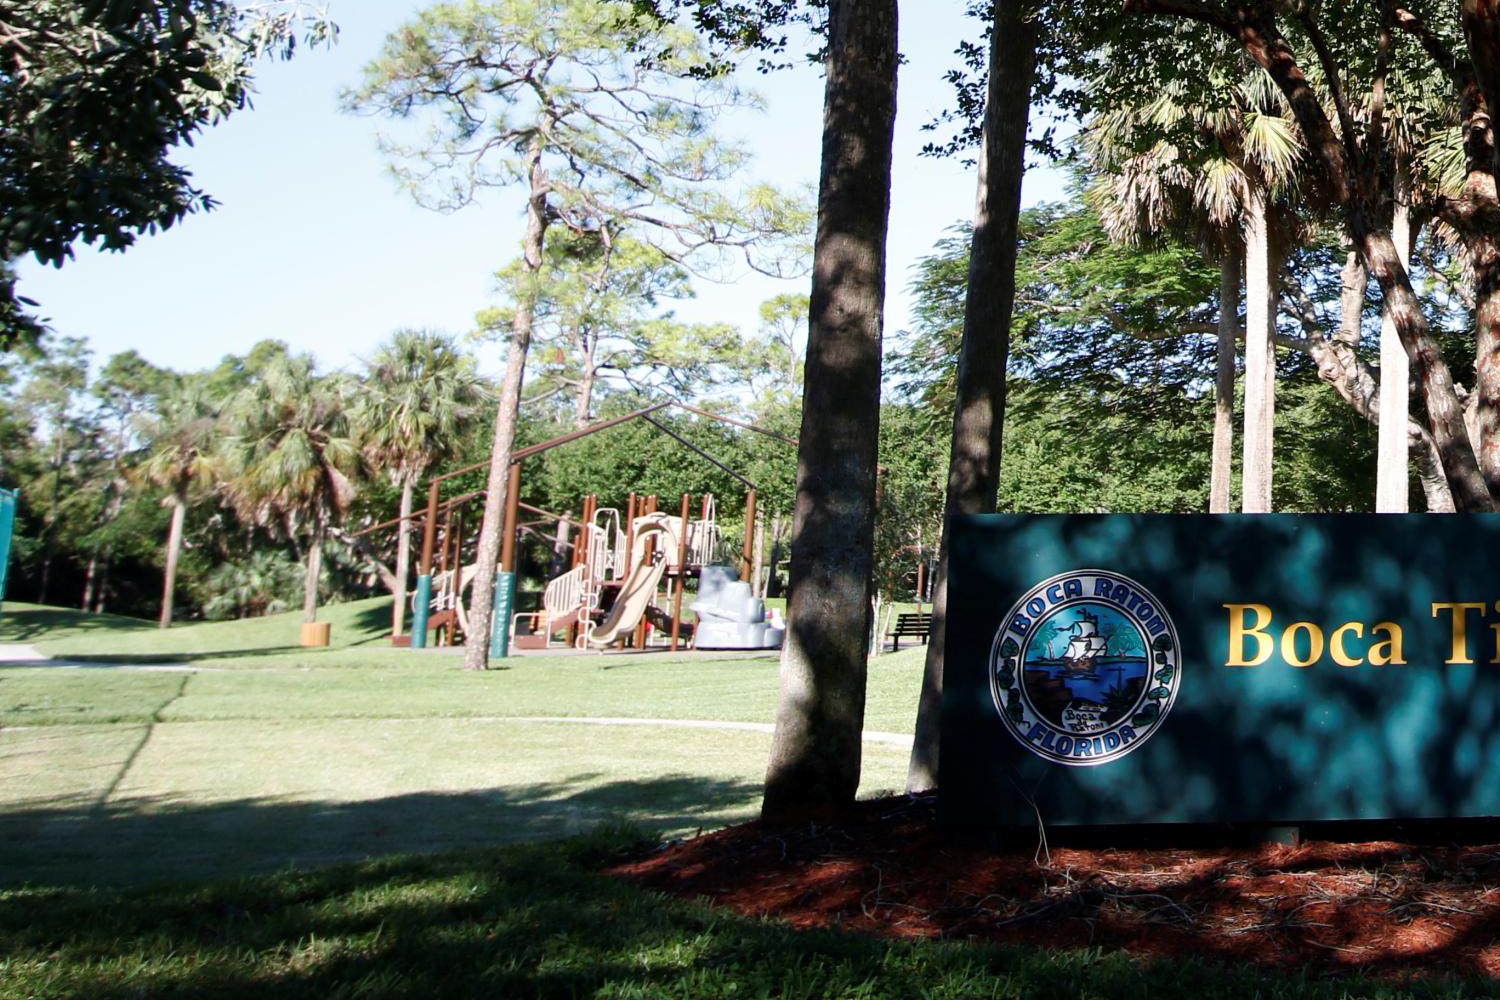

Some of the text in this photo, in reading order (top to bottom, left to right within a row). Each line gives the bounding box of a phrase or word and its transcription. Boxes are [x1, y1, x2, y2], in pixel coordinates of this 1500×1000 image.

[1009, 578, 1166, 638] BOCA RATON
[1223, 602, 1407, 667] Boca
[1064, 709, 1097, 720] Boca
[1027, 722, 1136, 757] FLORIDA
